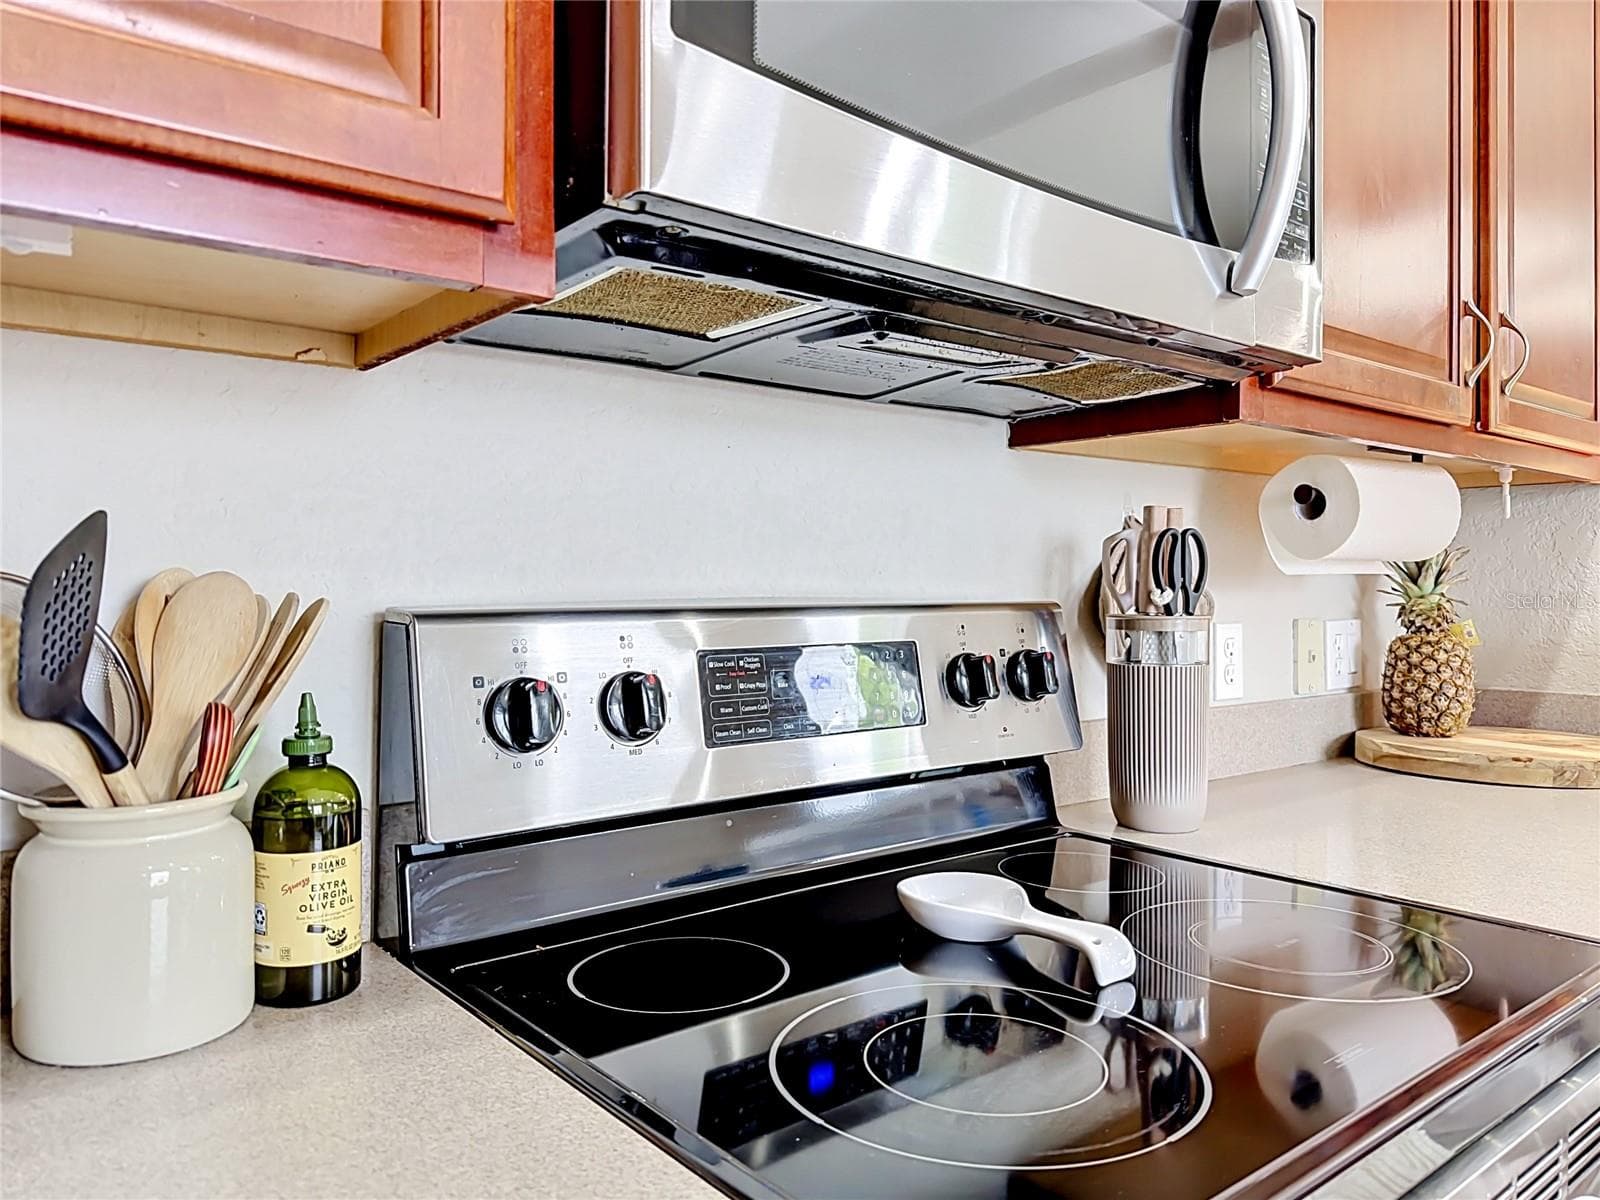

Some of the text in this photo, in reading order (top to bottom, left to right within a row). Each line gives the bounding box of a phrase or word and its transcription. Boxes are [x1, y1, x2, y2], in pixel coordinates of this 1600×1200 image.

[514, 661, 528, 669] OFF
[628, 748, 643, 756] MED
[311, 857, 346, 871] PRIANO
[311, 878, 346, 892] EXTRA
[308, 888, 348, 901] VIRGIN
[299, 900, 336, 913] OLIVE
[339, 895, 354, 906] OIL
